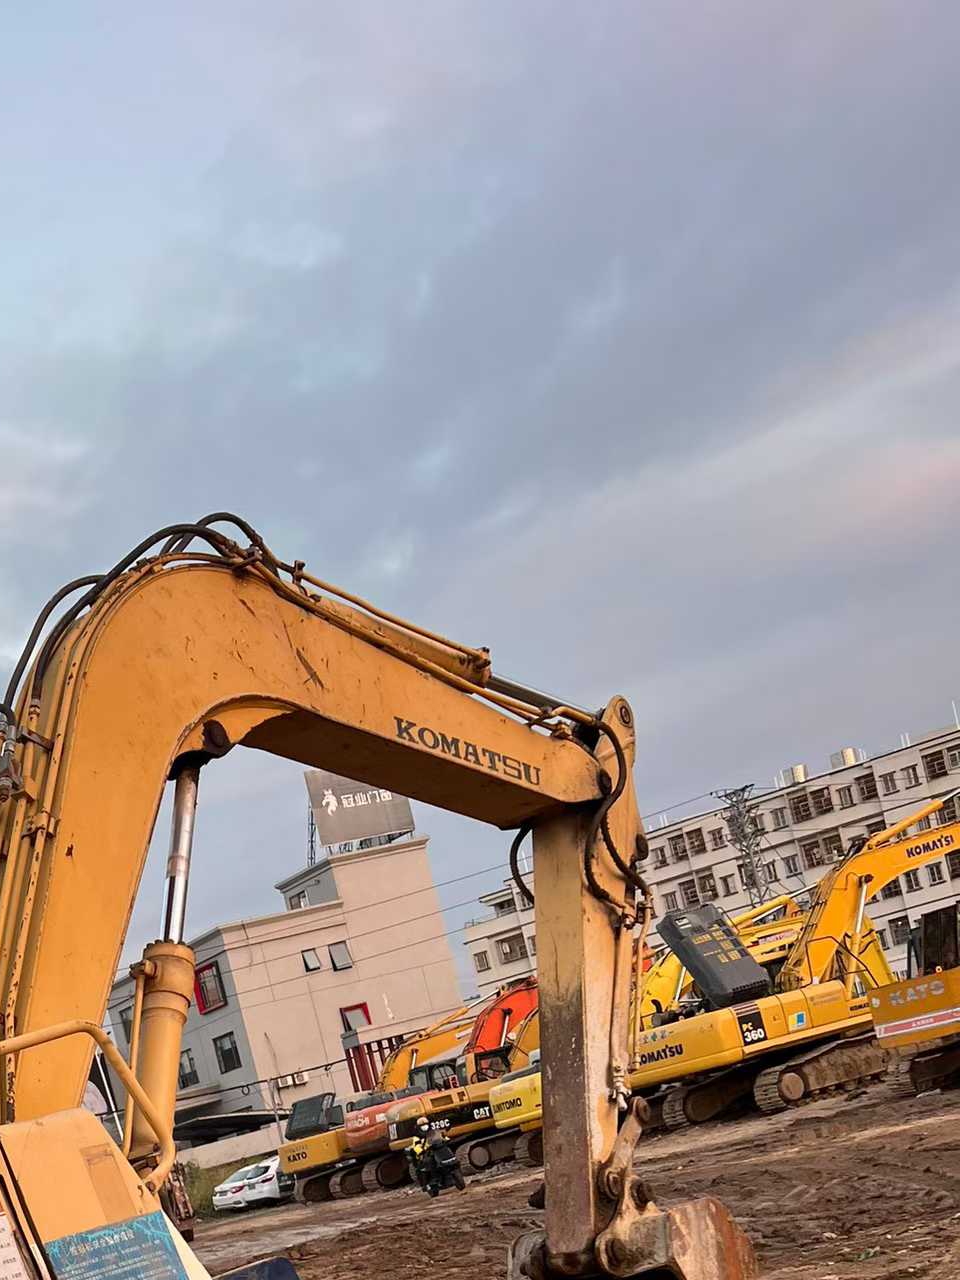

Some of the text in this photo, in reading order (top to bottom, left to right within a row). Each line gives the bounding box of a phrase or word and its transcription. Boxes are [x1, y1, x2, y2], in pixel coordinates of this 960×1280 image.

[393, 716, 541, 785] KOMATSU
[744, 1028, 765, 1043] 360
[473, 1106, 490, 1120] CAT
